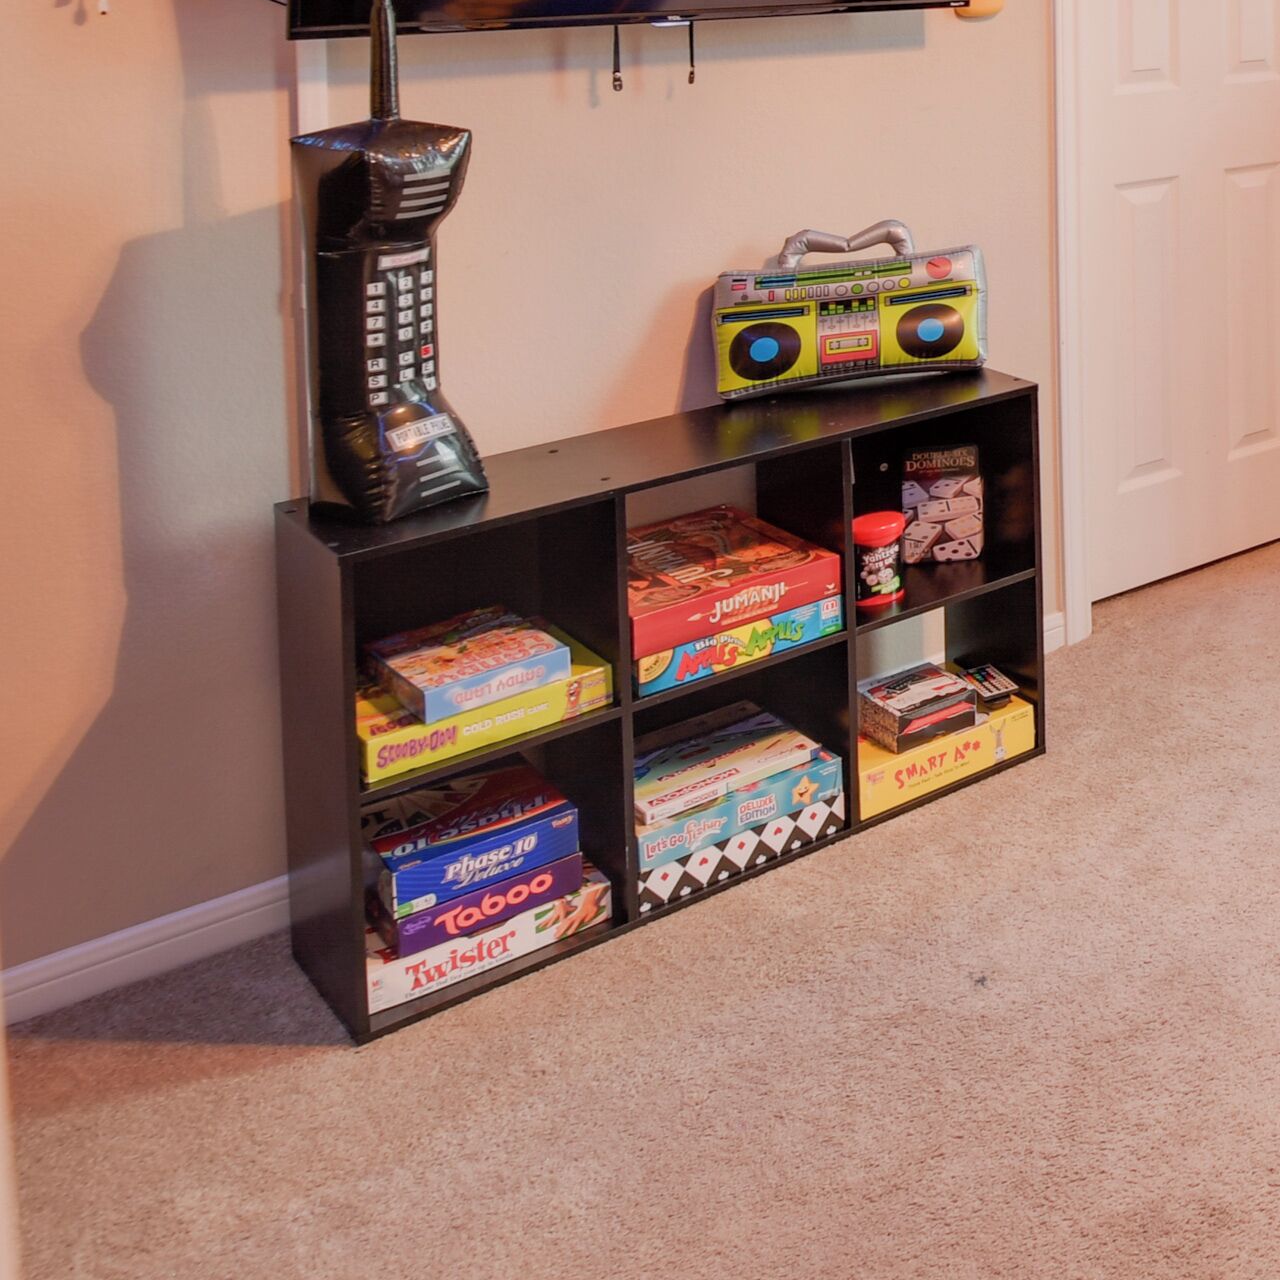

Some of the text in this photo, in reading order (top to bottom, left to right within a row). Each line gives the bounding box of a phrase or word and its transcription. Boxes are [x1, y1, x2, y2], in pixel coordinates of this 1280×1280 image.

[906, 456, 976, 472] DOMINOES
[709, 582, 786, 624] JUMANJI
[693, 637, 718, 651] Big
[894, 750, 948, 790] SMART
[738, 794, 775, 814] DELUXE
[739, 804, 776, 824] EDITION
[440, 832, 540, 885] Phase 10
[451, 856, 525, 891] Deluxe
[433, 871, 554, 936] Taboo
[405, 929, 517, 992] Twister
